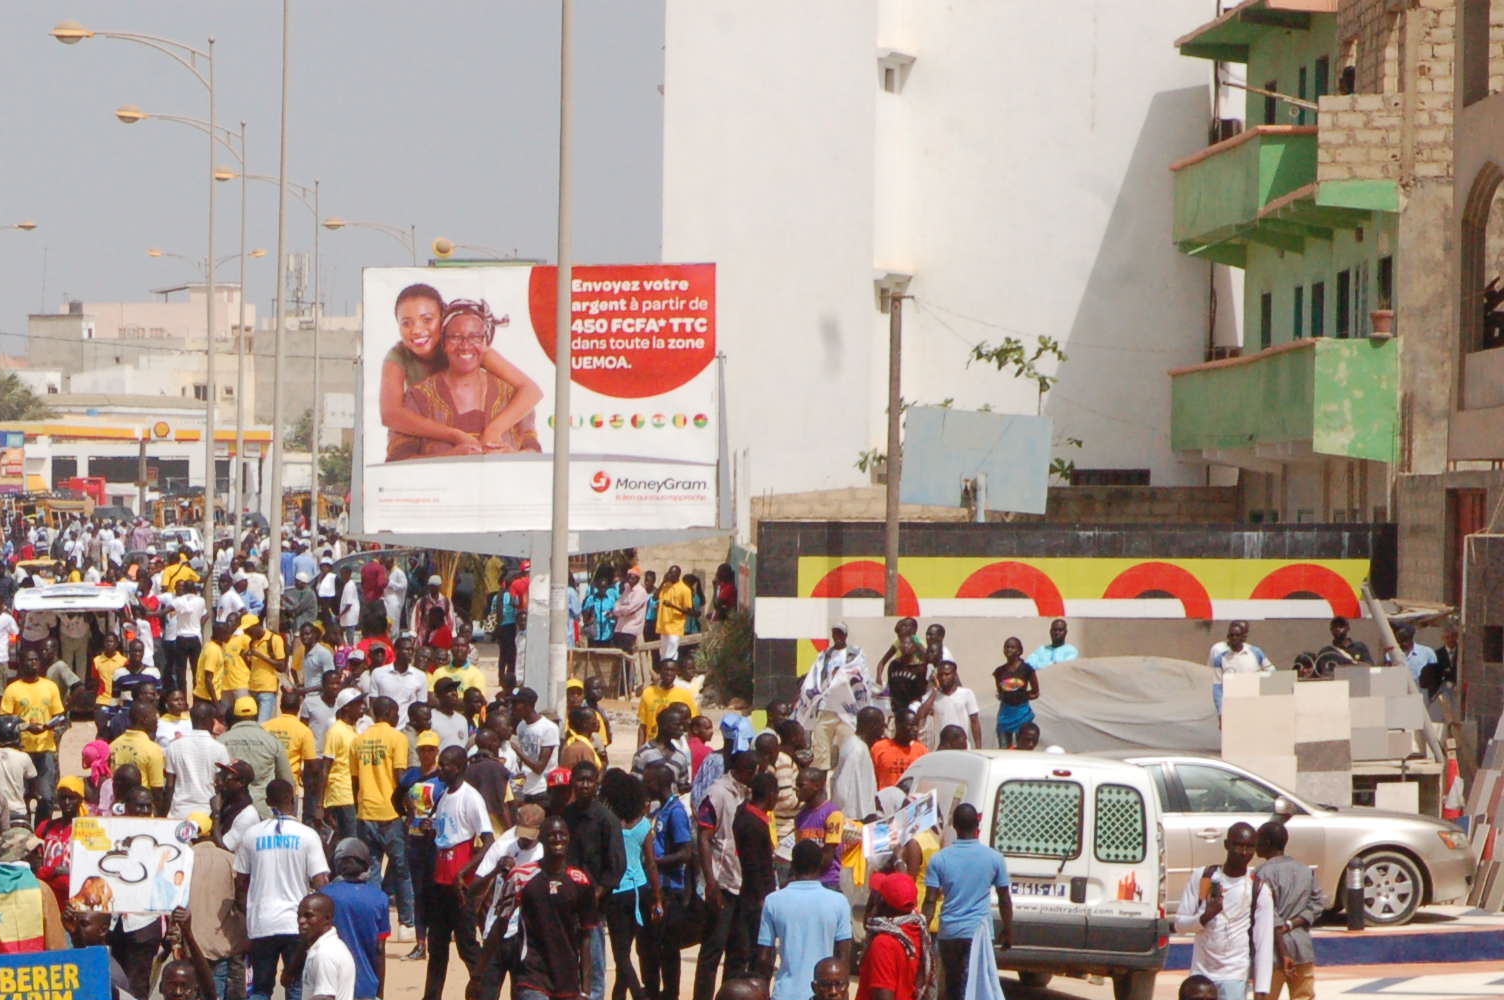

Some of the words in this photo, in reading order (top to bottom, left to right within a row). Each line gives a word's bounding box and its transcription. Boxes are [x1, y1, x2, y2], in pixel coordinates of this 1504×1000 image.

[571, 279, 640, 295] Envoyez
[643, 278, 689, 291] votre
[571, 298, 627, 315] argent
[629, 297, 639, 311] à
[642, 297, 687, 314] partir
[688, 297, 708, 311] de
[571, 318, 608, 334] 450
[669, 317, 708, 333] TTC
[571, 336, 607, 350] dans
[609, 337, 650, 349] toute
[652, 335, 665, 349] la
[667, 338, 705, 349] zone
[571, 355, 632, 370] UEMOA.
[615, 477, 707, 493] MoneyGram
